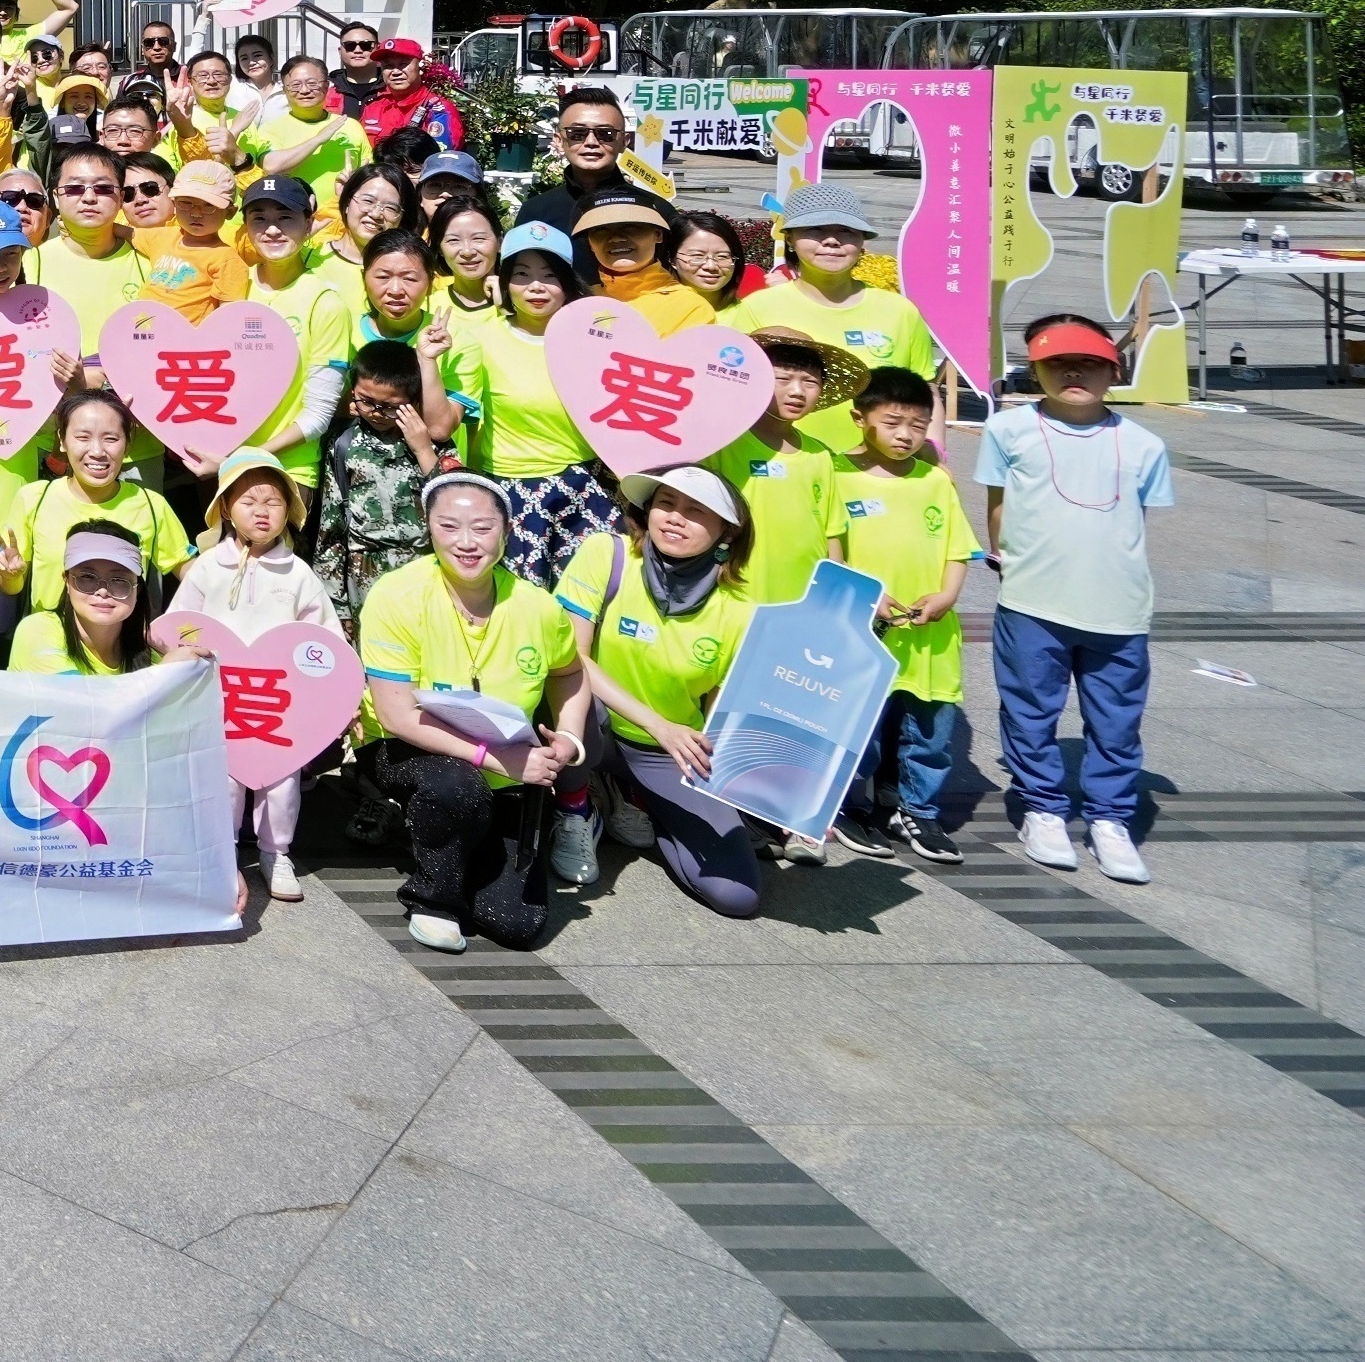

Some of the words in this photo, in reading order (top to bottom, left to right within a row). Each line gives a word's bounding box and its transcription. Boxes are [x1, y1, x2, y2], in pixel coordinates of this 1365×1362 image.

[633, 80, 725, 111] 与星同行
[730, 80, 794, 104] Welcome
[837, 82, 898, 98] 与星同行
[909, 82, 971, 98] 千米贤爱
[1073, 85, 1130, 101] 与星同行
[1105, 107, 1164, 124] 千米贤爱
[670, 118, 761, 146] 千米献爱
[263, 179, 276, 191] H
[625, 158, 658, 186] 好运传给你
[1002, 118, 1016, 267] 文明始于心公益践于行
[946, 123, 964, 293] 微小善意汇聚人间温暖
[155, 350, 238, 425] 爱
[590, 352, 695, 446] 爱
[773, 665, 842, 702] REJUVE
[220, 664, 294, 748] 爱
[804, 718, 828, 734] POUCH
